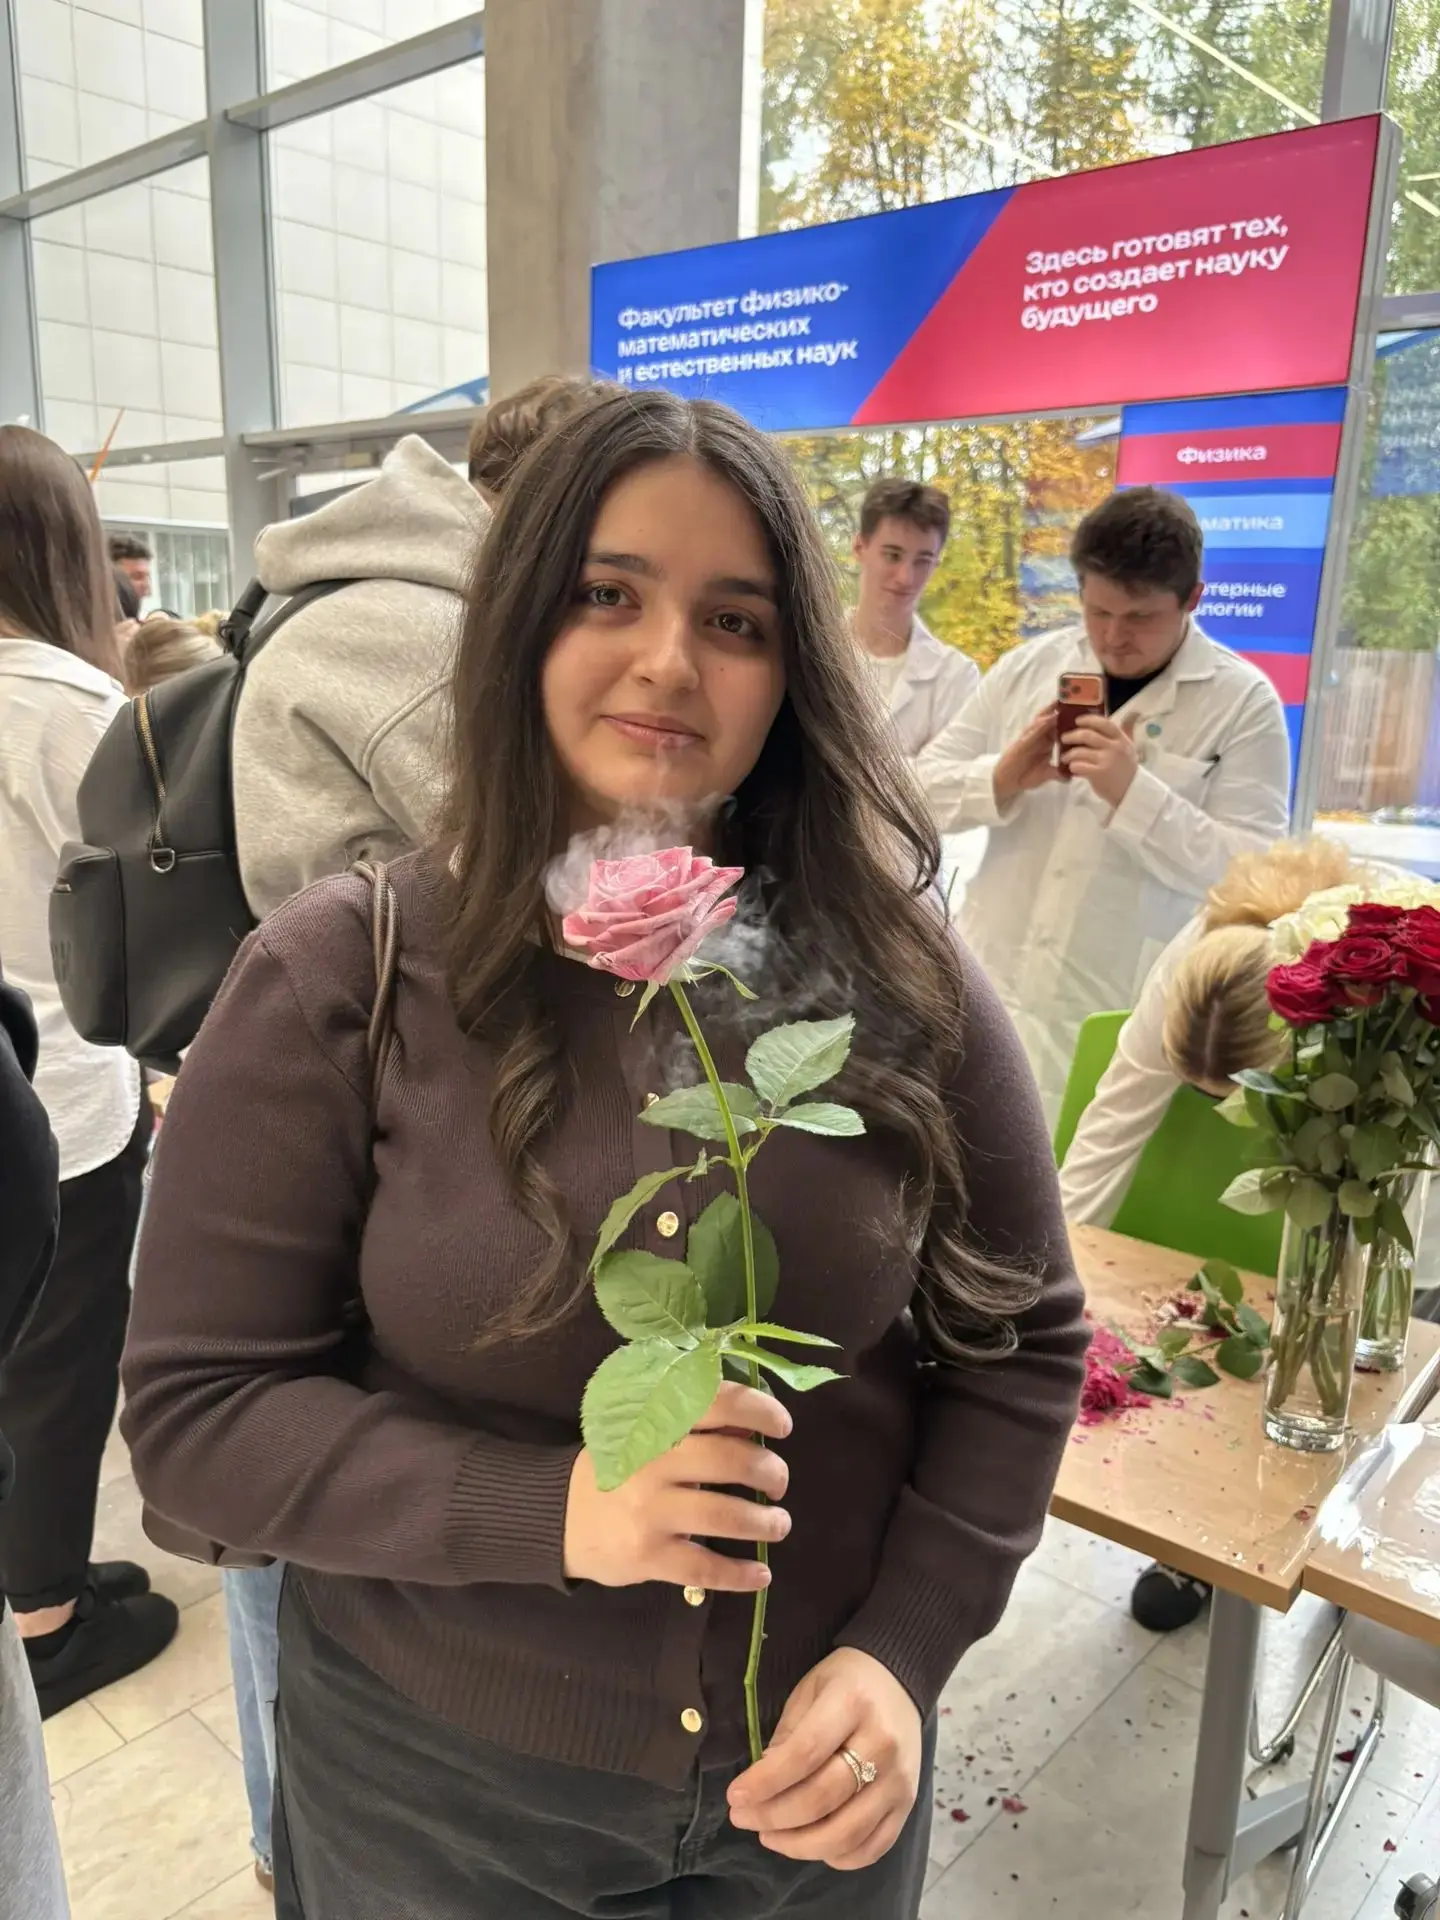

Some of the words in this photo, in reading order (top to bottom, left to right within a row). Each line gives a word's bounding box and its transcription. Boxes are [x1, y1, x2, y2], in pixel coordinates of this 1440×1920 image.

[1025, 246, 1109, 274] Здесь
[1112, 225, 1226, 260] готовят
[1230, 214, 1289, 239] тех,
[1024, 279, 1069, 302] кто
[1073, 260, 1192, 290] создает
[1195, 245, 1289, 276] науку
[618, 298, 738, 329] Факультет
[741, 281, 848, 316] физико-
[1021, 294, 1158, 330] будущего
[618, 317, 811, 358] математических
[617, 367, 632, 384] и
[635, 350, 793, 382] естественных
[797, 341, 858, 366] наук
[1177, 446, 1267, 463] Физика
[1200, 516, 1284, 531] матика
[1196, 602, 1263, 617] логии
[1203, 582, 1286, 599] терные
